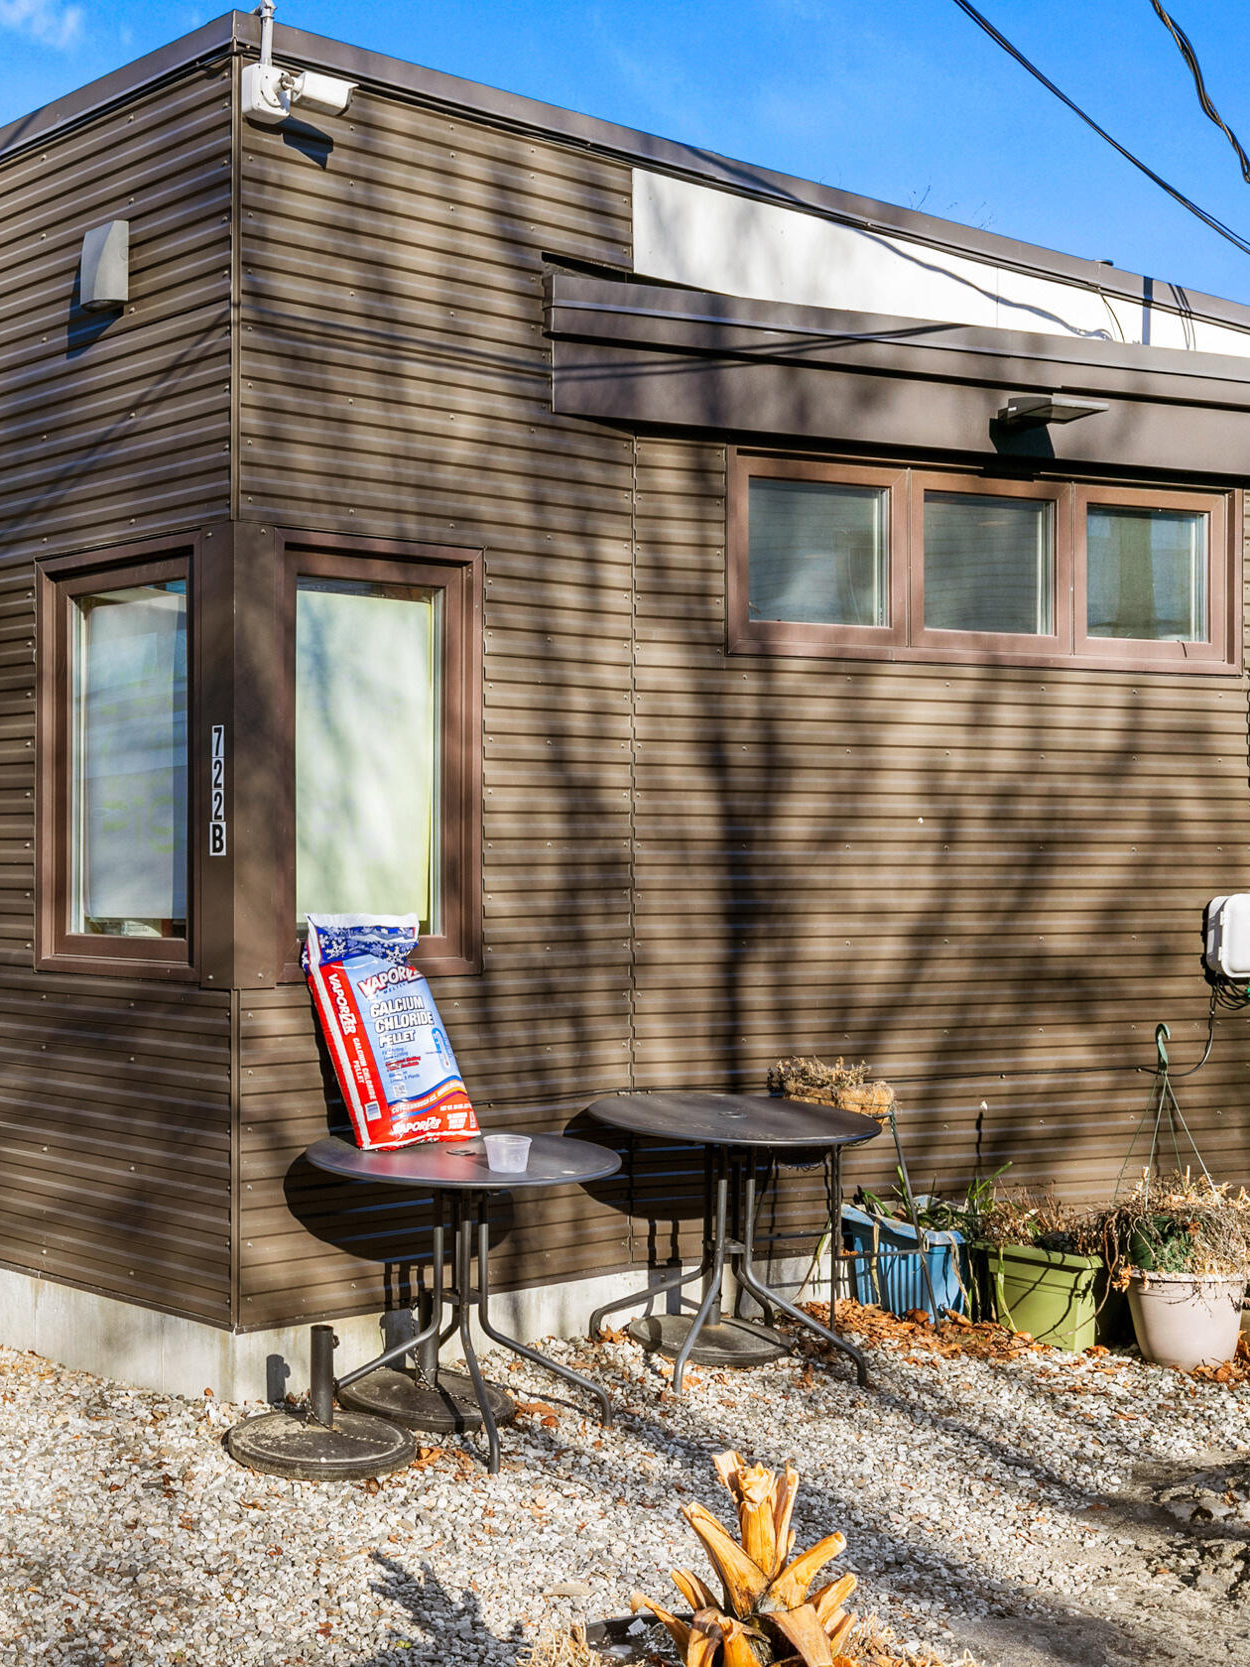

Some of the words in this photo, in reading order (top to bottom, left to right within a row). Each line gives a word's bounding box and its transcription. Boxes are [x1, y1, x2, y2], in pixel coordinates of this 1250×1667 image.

[370, 996, 424, 1018] CALCIUM
[375, 1011, 434, 1034] CHLORIDE
[379, 1029, 415, 1048] PELLET
[352, 1038, 367, 1067] CALCIUM
[362, 1067, 377, 1100] CHLORIDE
[352, 1060, 365, 1083] PELLET
